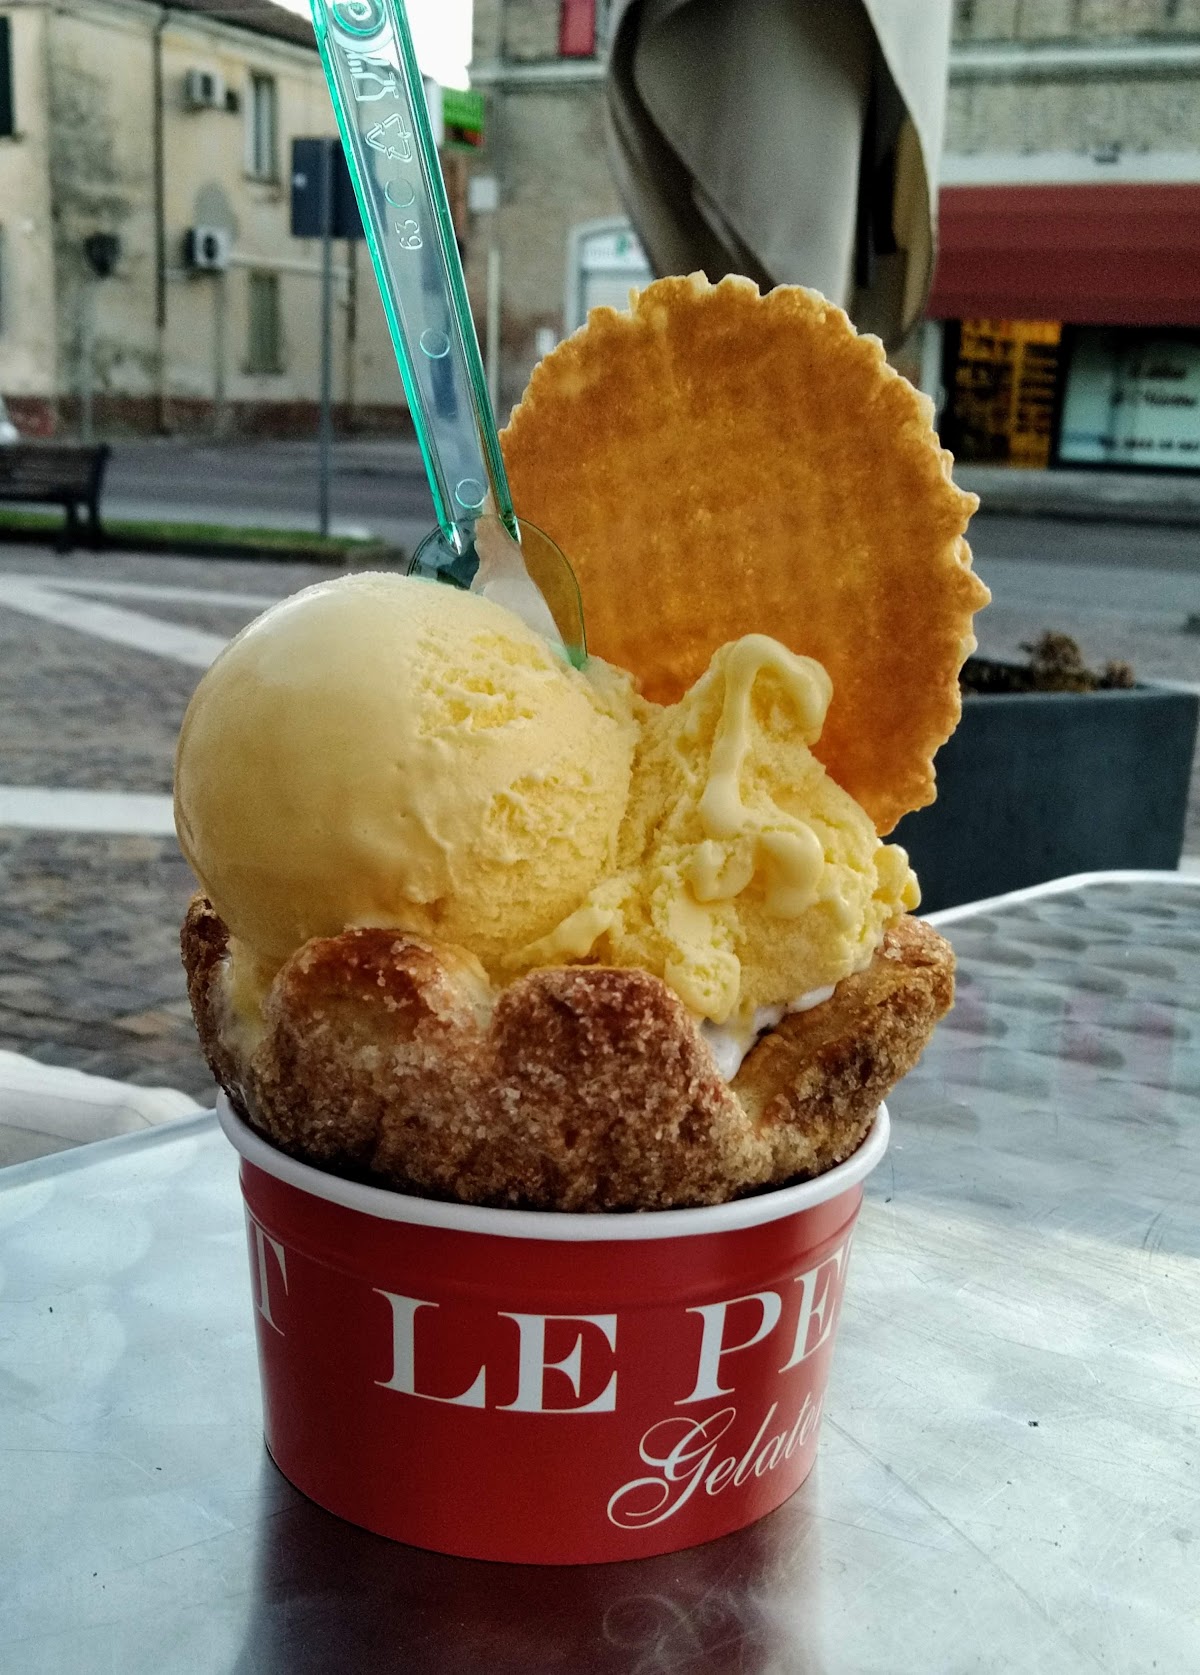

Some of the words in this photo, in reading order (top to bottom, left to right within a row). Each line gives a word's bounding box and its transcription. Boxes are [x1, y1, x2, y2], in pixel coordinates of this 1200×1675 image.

[394, 219, 423, 250] 63
[373, 1288, 619, 1414] LE
[674, 1232, 853, 1406] PE
